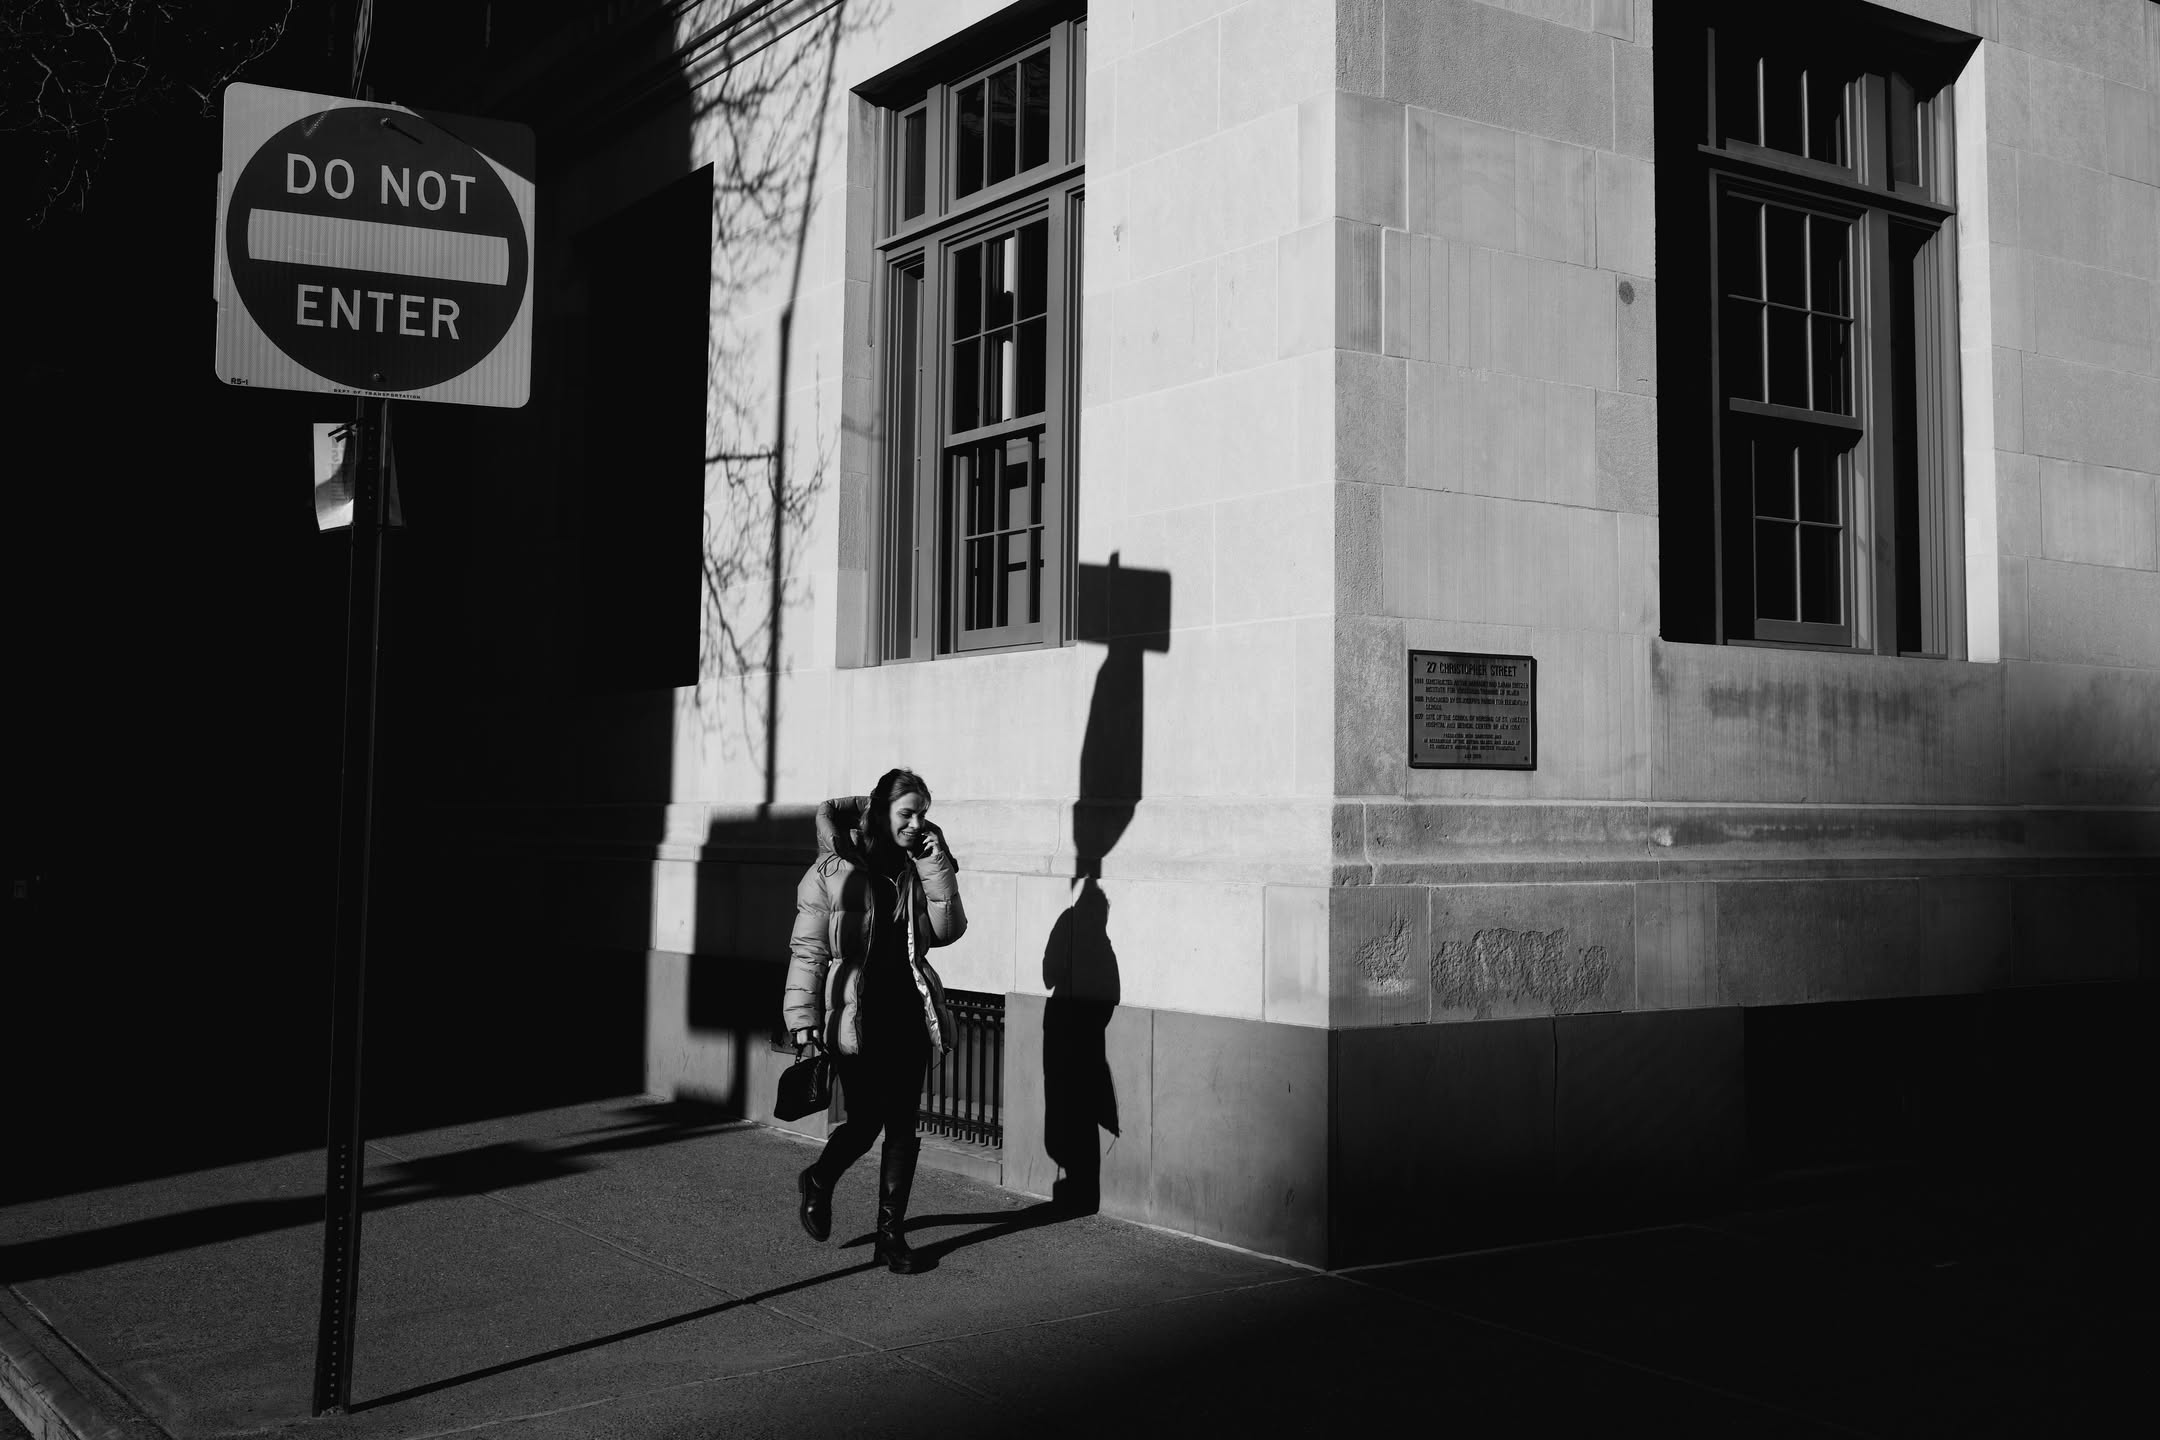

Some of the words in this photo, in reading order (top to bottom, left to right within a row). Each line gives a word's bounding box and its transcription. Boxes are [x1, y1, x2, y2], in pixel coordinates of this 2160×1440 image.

[286, 153, 355, 200] DO
[380, 165, 476, 215] NOT
[296, 284, 461, 340] ENTER
[365, 391, 421, 399] TRANSPORTATION
[1427, 662, 1437, 673] 27
[1440, 663, 1487, 675] CHRISTOPHER
[1491, 665, 1517, 676] STREET
